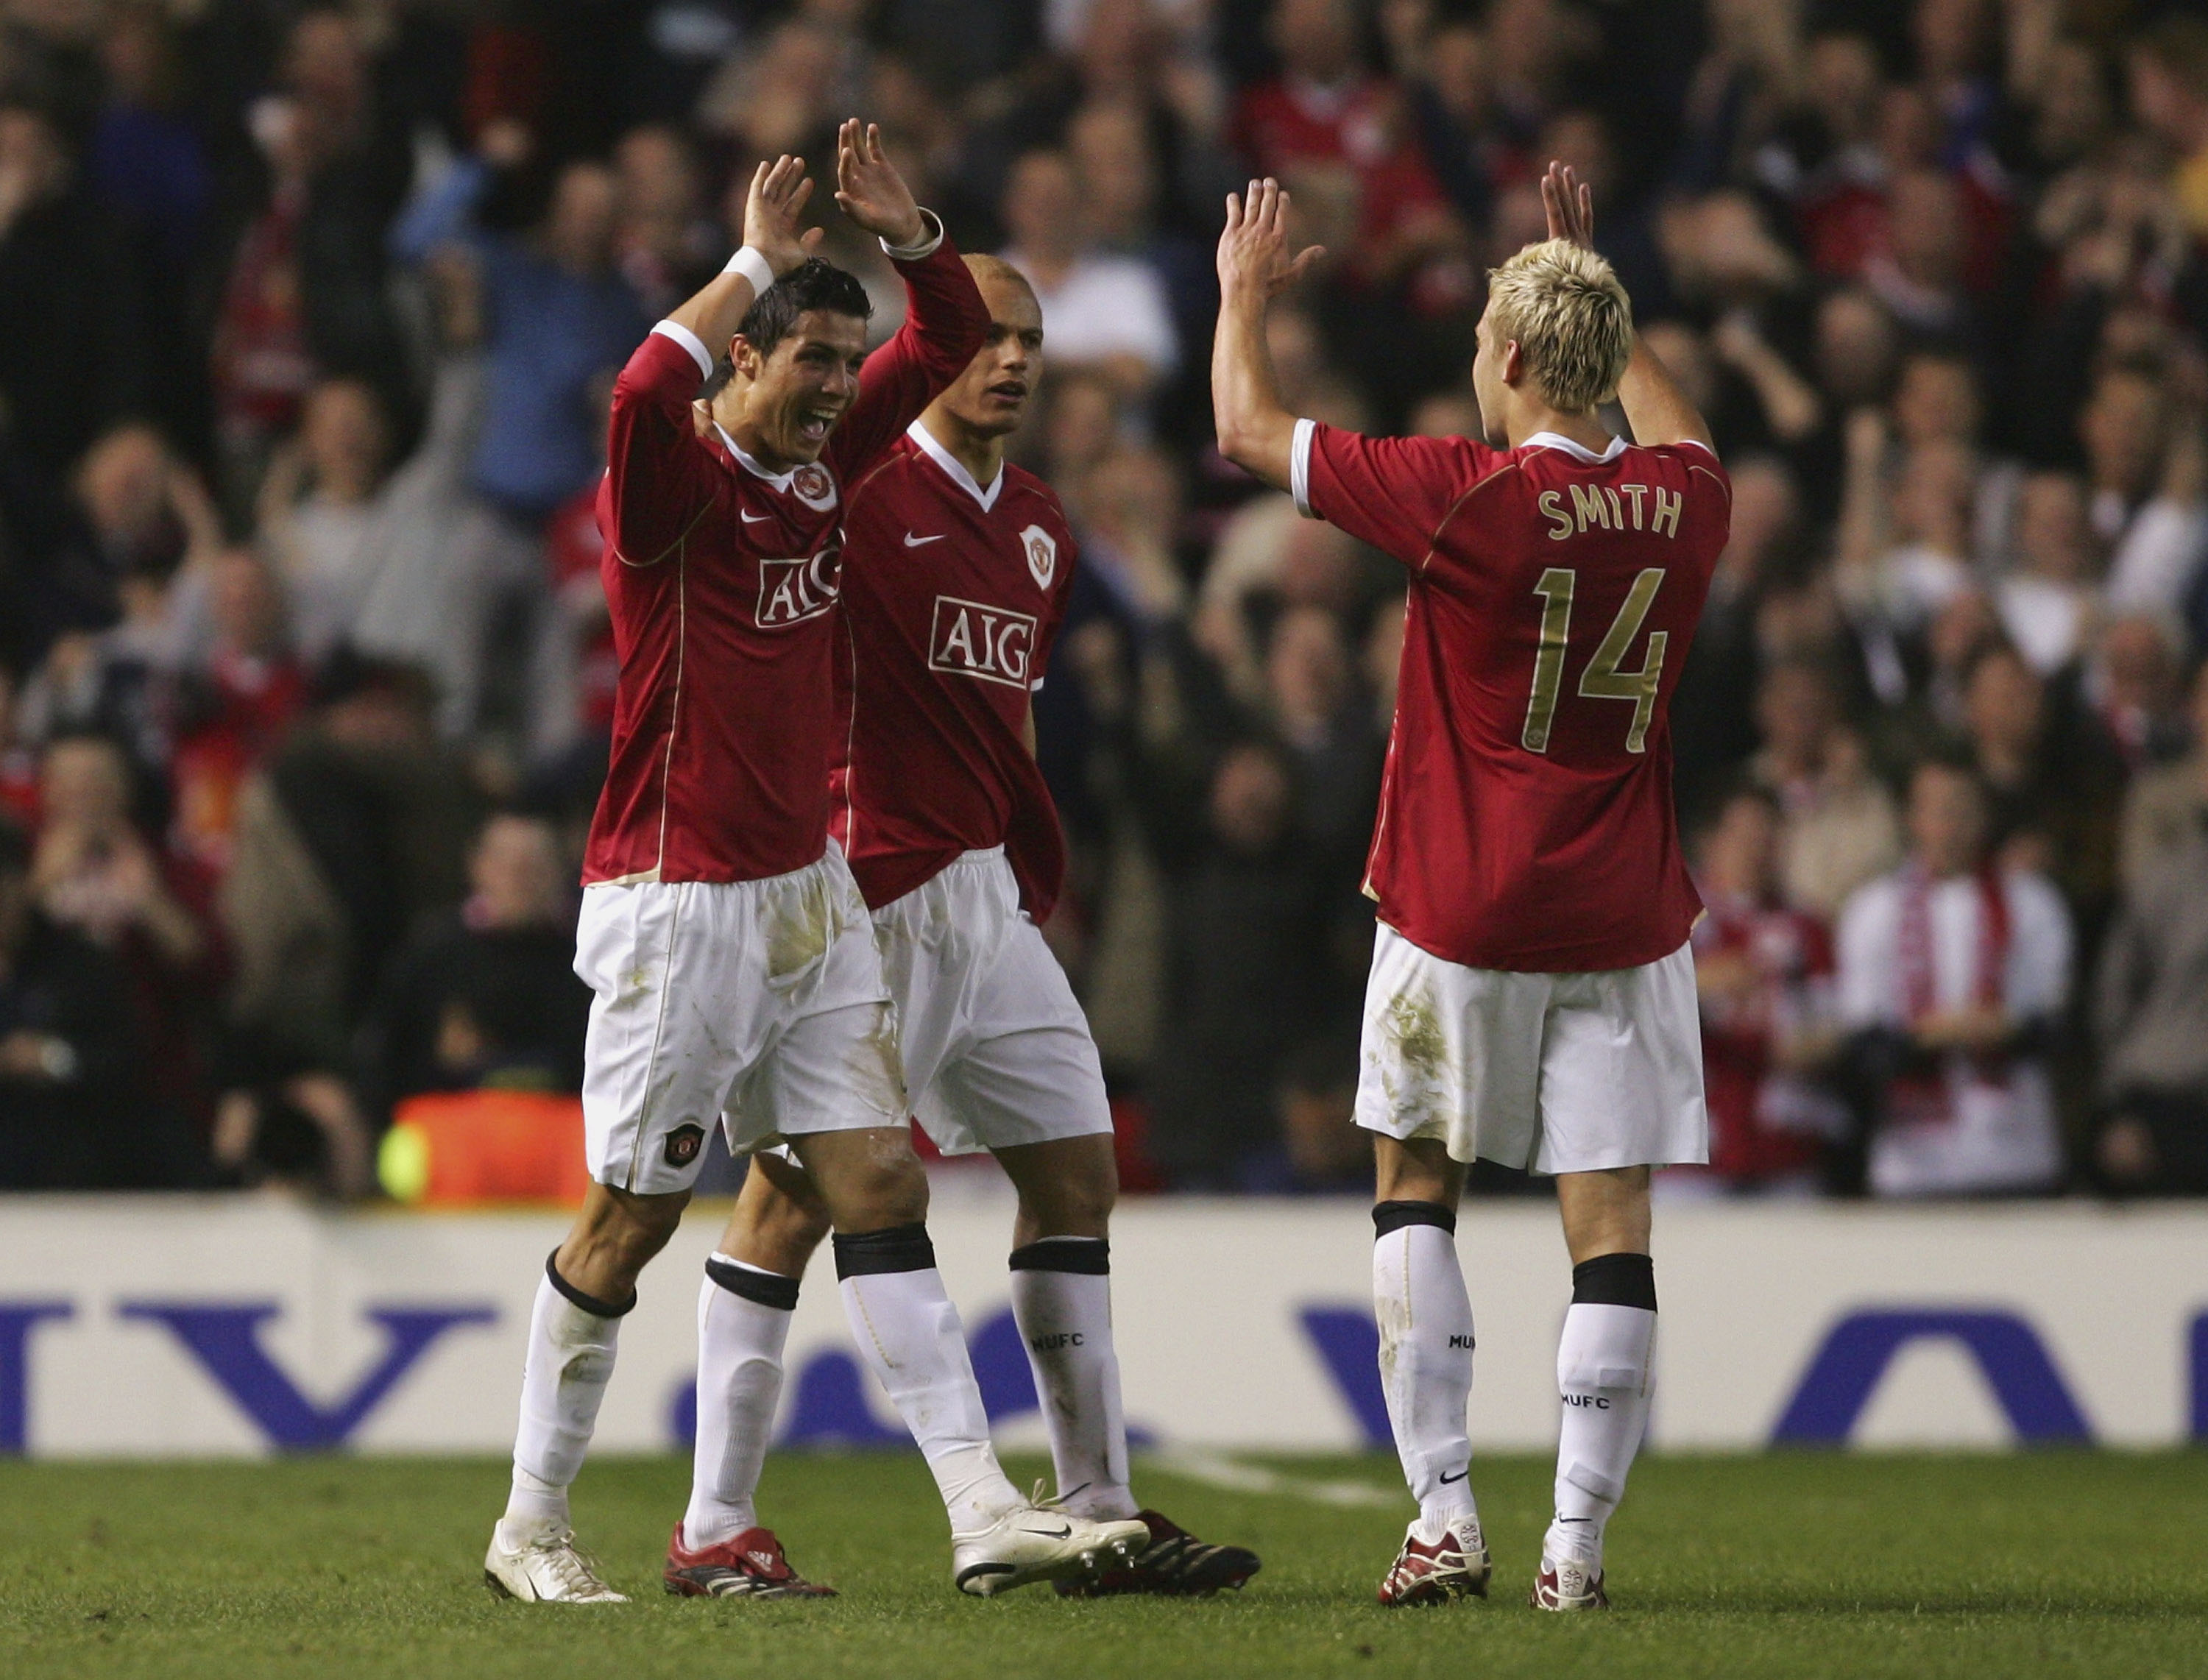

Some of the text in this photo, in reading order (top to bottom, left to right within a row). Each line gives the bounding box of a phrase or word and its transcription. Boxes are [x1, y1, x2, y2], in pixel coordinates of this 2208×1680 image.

[1538, 484, 1682, 539] SMITH
[935, 608, 1029, 678] AIG
[1521, 567, 1669, 754] 14
[1031, 1333, 1084, 1352] MUFC
[1561, 1394, 1610, 1409] MUFC
